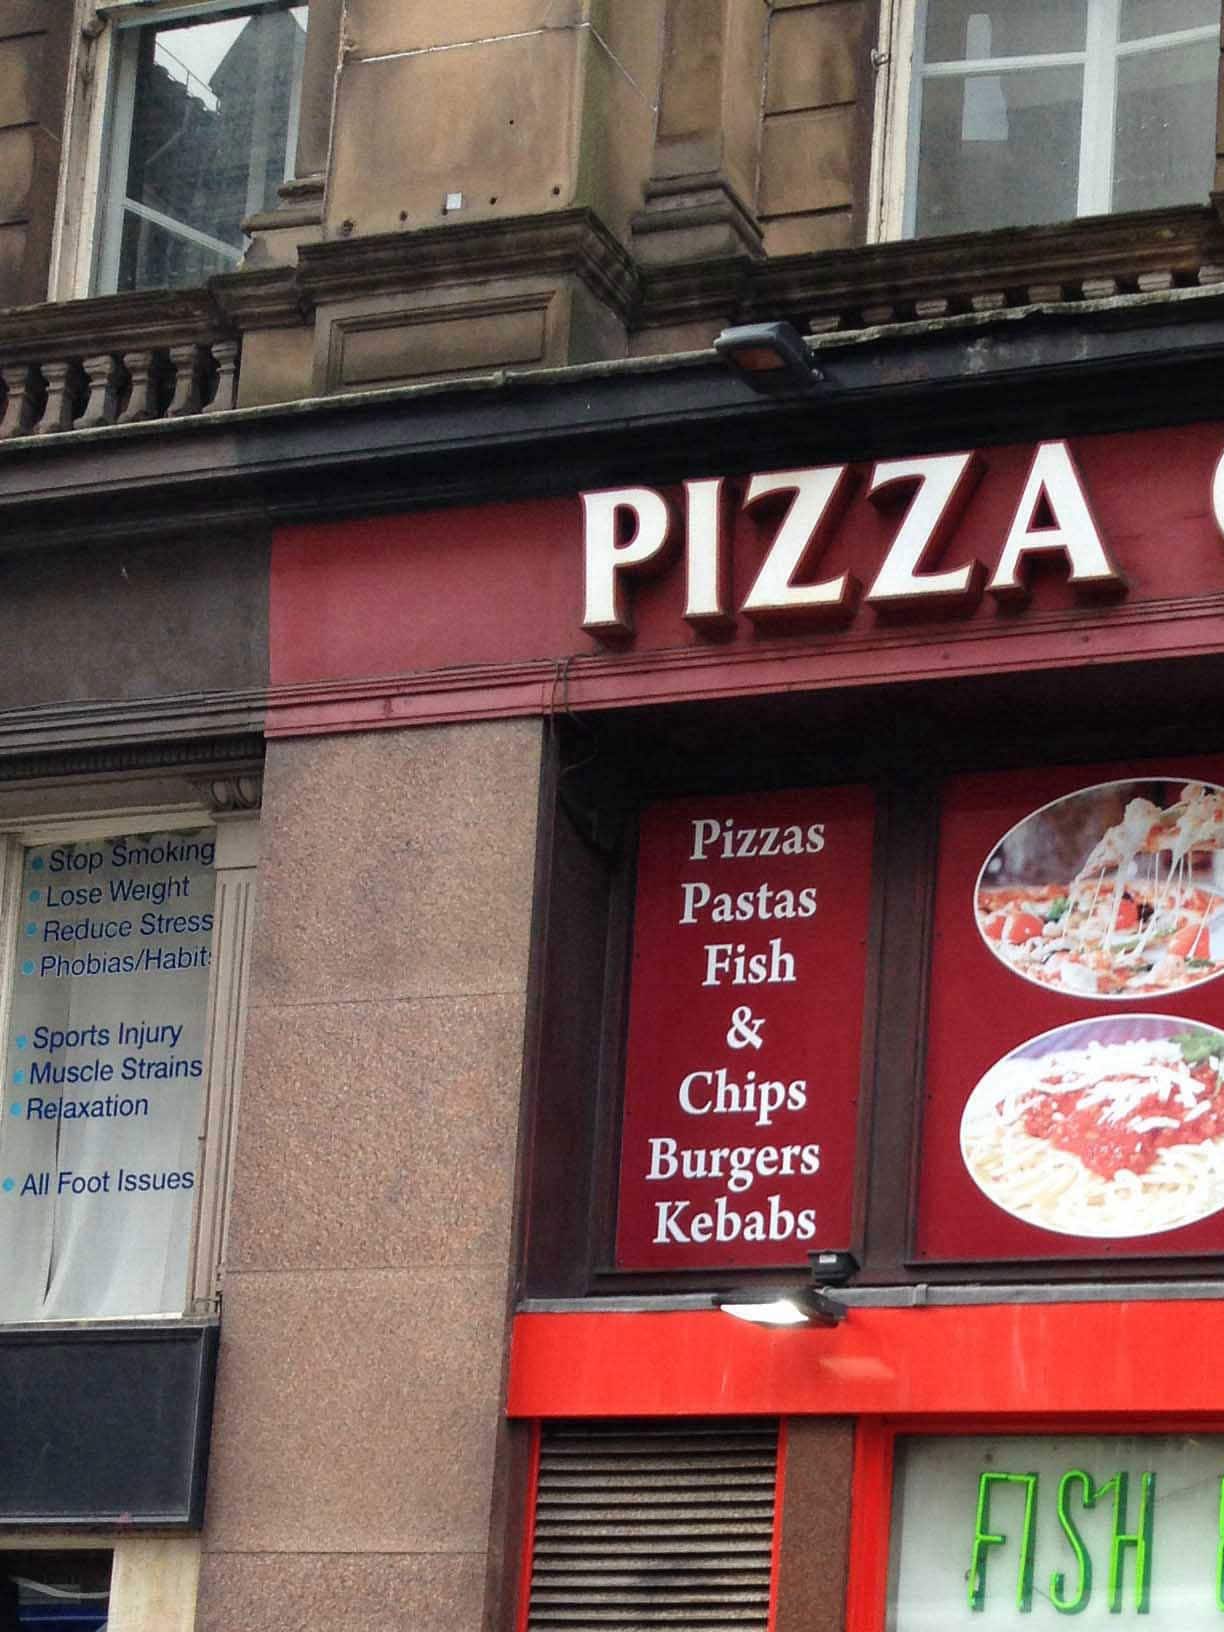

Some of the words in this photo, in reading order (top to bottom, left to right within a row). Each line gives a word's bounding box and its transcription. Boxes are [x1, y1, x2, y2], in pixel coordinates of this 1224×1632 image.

[581, 438, 1121, 628] PIZZA
[48, 848, 104, 875] Stop
[111, 838, 216, 872] Smoking
[688, 818, 826, 860] Pizzas
[46, 883, 103, 906] Lose
[109, 875, 190, 908] Weight
[678, 882, 817, 925] Pastas
[43, 919, 133, 942] Reduce
[139, 912, 214, 936] Stress
[40, 947, 212, 978] Phobias/Habit
[702, 936, 797, 987] Fish
[33, 1024, 110, 1054] Sports
[117, 1021, 183, 1050] Injury
[726, 1005, 765, 1051] &
[29, 1060, 114, 1083] Muscle
[120, 1055, 203, 1080] Strains
[26, 1095, 149, 1120] Relaxation
[678, 1068, 808, 1126] Chips
[20, 1172, 50, 1196] All
[56, 1170, 110, 1194] Foot
[117, 1167, 195, 1191] Issues
[645, 1136, 821, 1192] Burgers
[652, 1194, 818, 1245] Kebabs
[968, 1469, 1156, 1615] FISH
